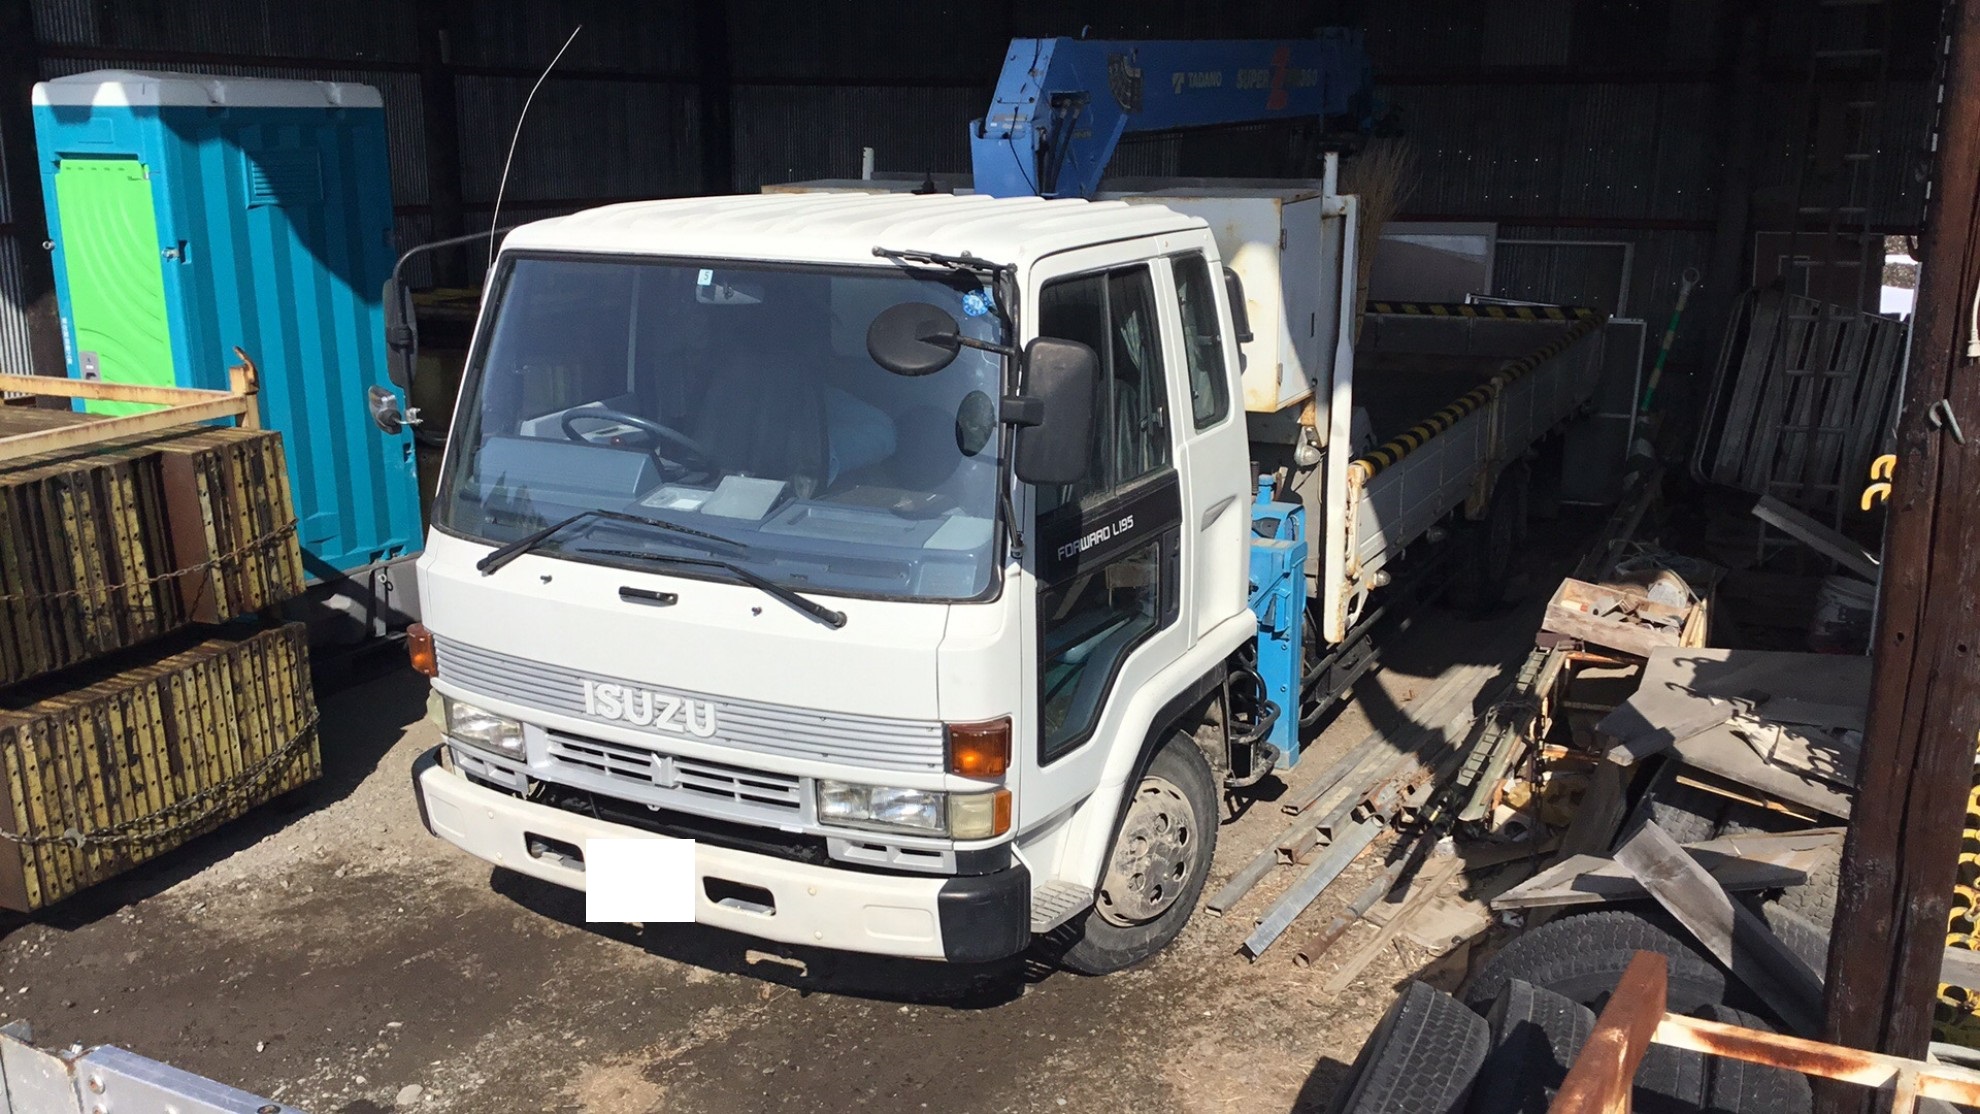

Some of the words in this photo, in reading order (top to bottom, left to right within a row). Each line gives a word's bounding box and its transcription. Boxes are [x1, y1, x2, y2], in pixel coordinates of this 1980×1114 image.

[1187, 71, 1223, 88] TADANO
[1236, 68, 1270, 90] SUPER
[1057, 525, 1111, 562] FORWARD
[1112, 514, 1134, 537] L195
[583, 680, 717, 738] ISUZU
